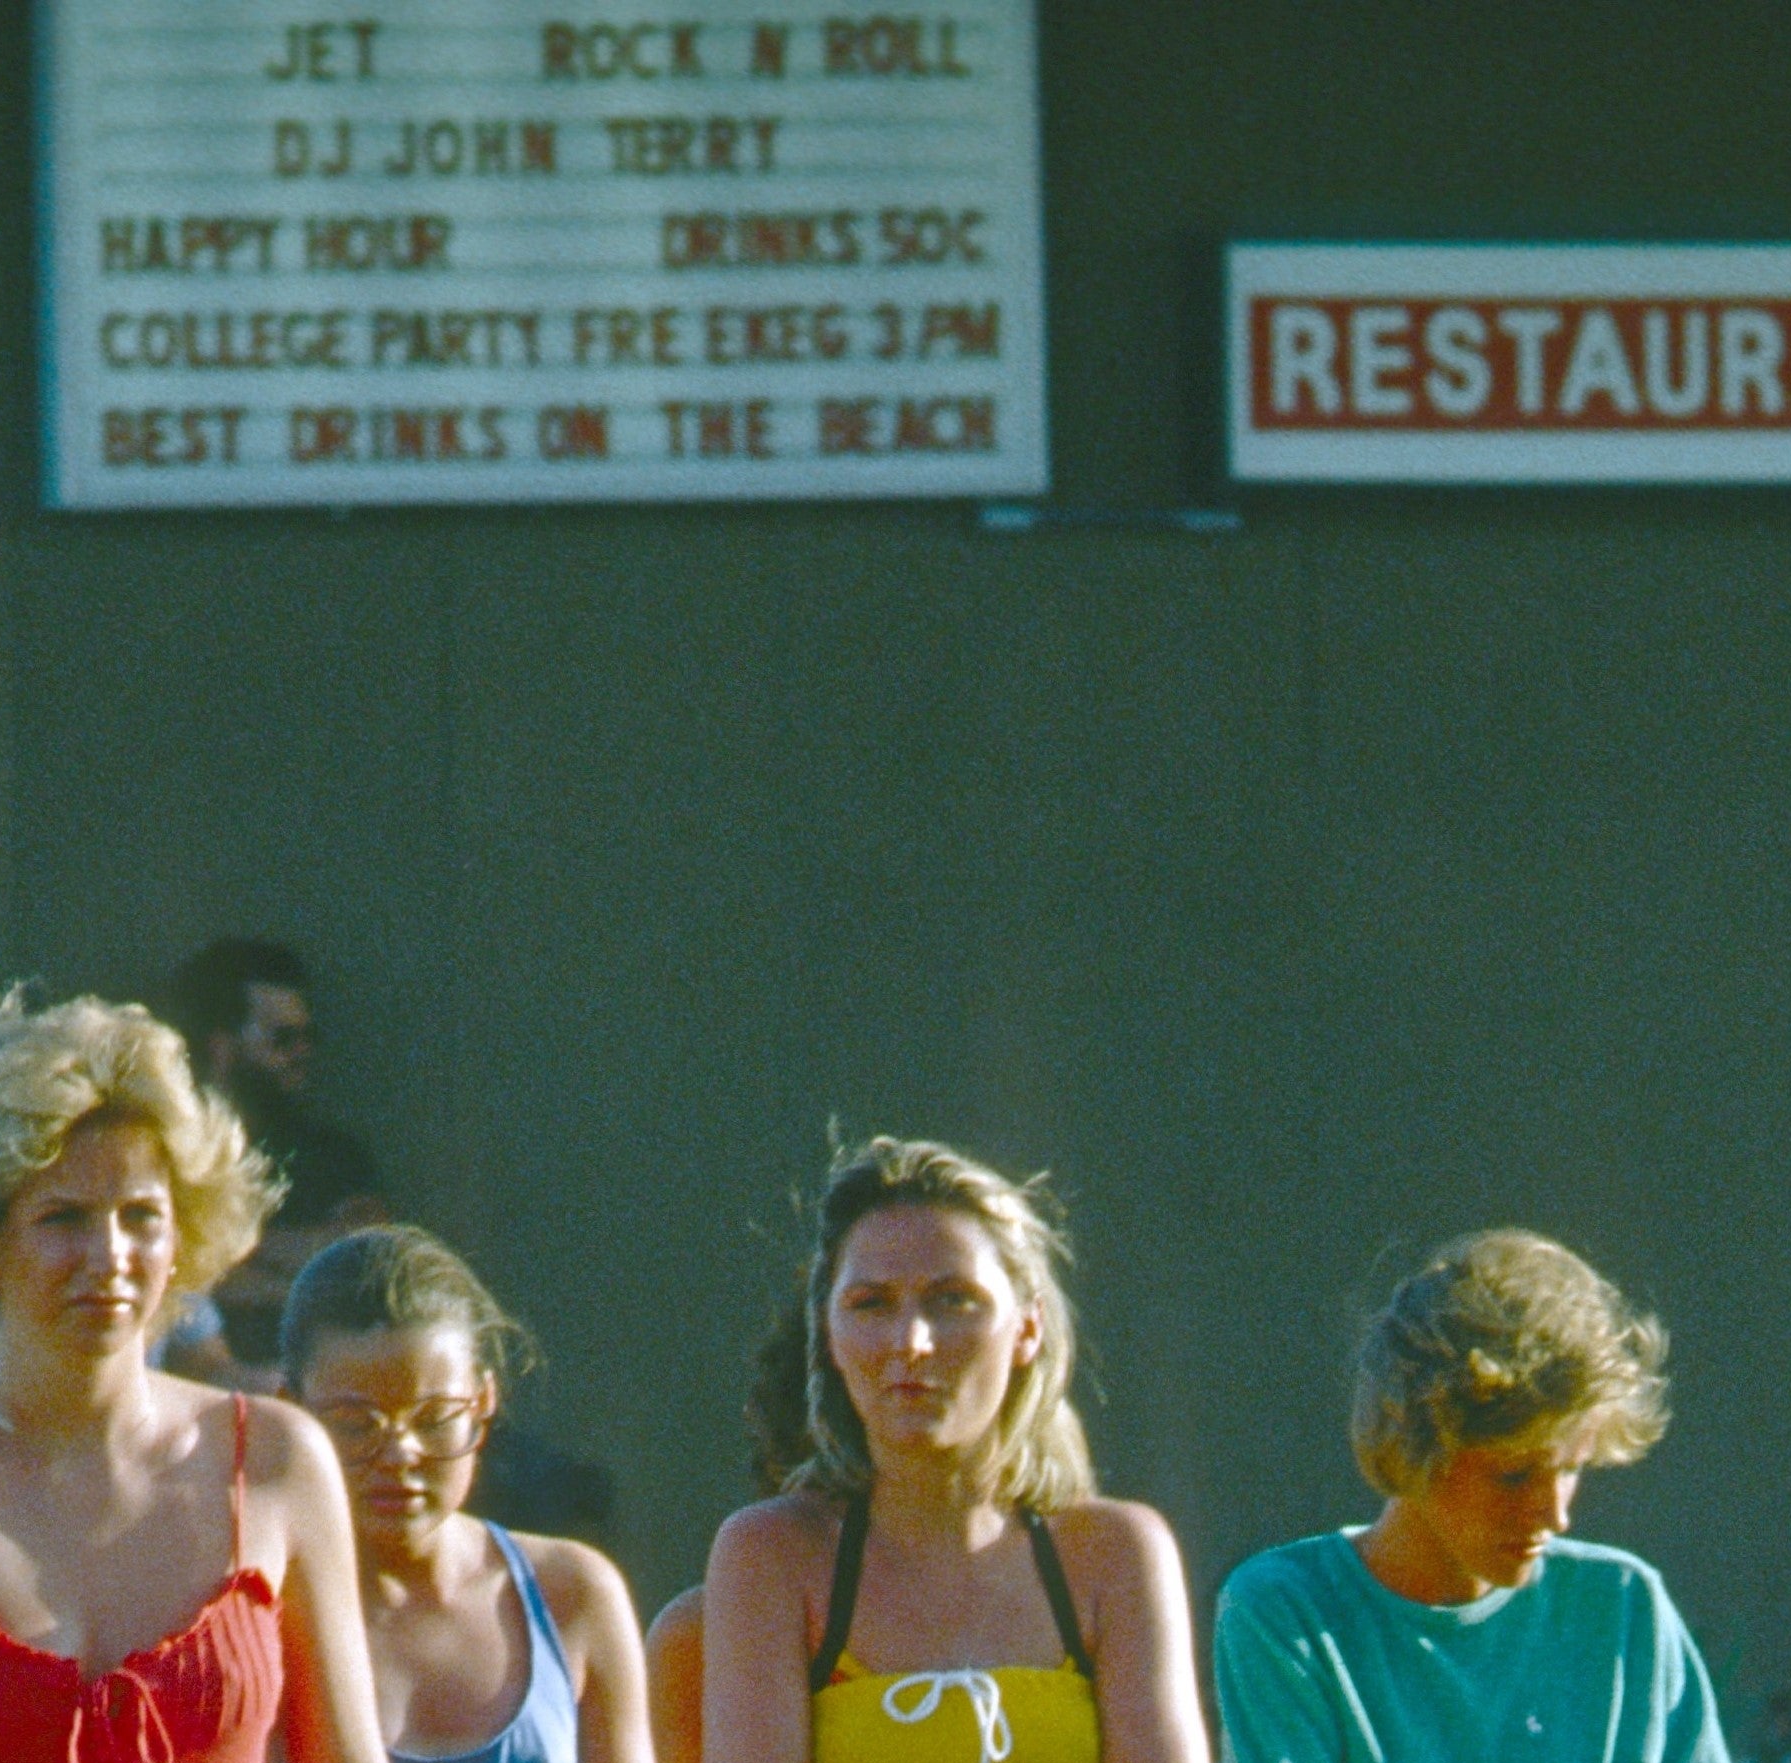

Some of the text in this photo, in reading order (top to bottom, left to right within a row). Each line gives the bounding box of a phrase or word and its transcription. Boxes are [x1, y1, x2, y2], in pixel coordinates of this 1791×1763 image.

[266, 18, 970, 80] JET ROCK N ROLL
[275, 117, 779, 175] DJ JOHN TERRY
[101, 215, 277, 269] HAPPY
[307, 215, 451, 268] HOUR
[663, 211, 860, 268] DRINKS
[101, 313, 349, 366] COLLEGE
[373, 311, 540, 365] PARTY
[104, 400, 997, 464] BEST DRINKS ON THE BEACH
